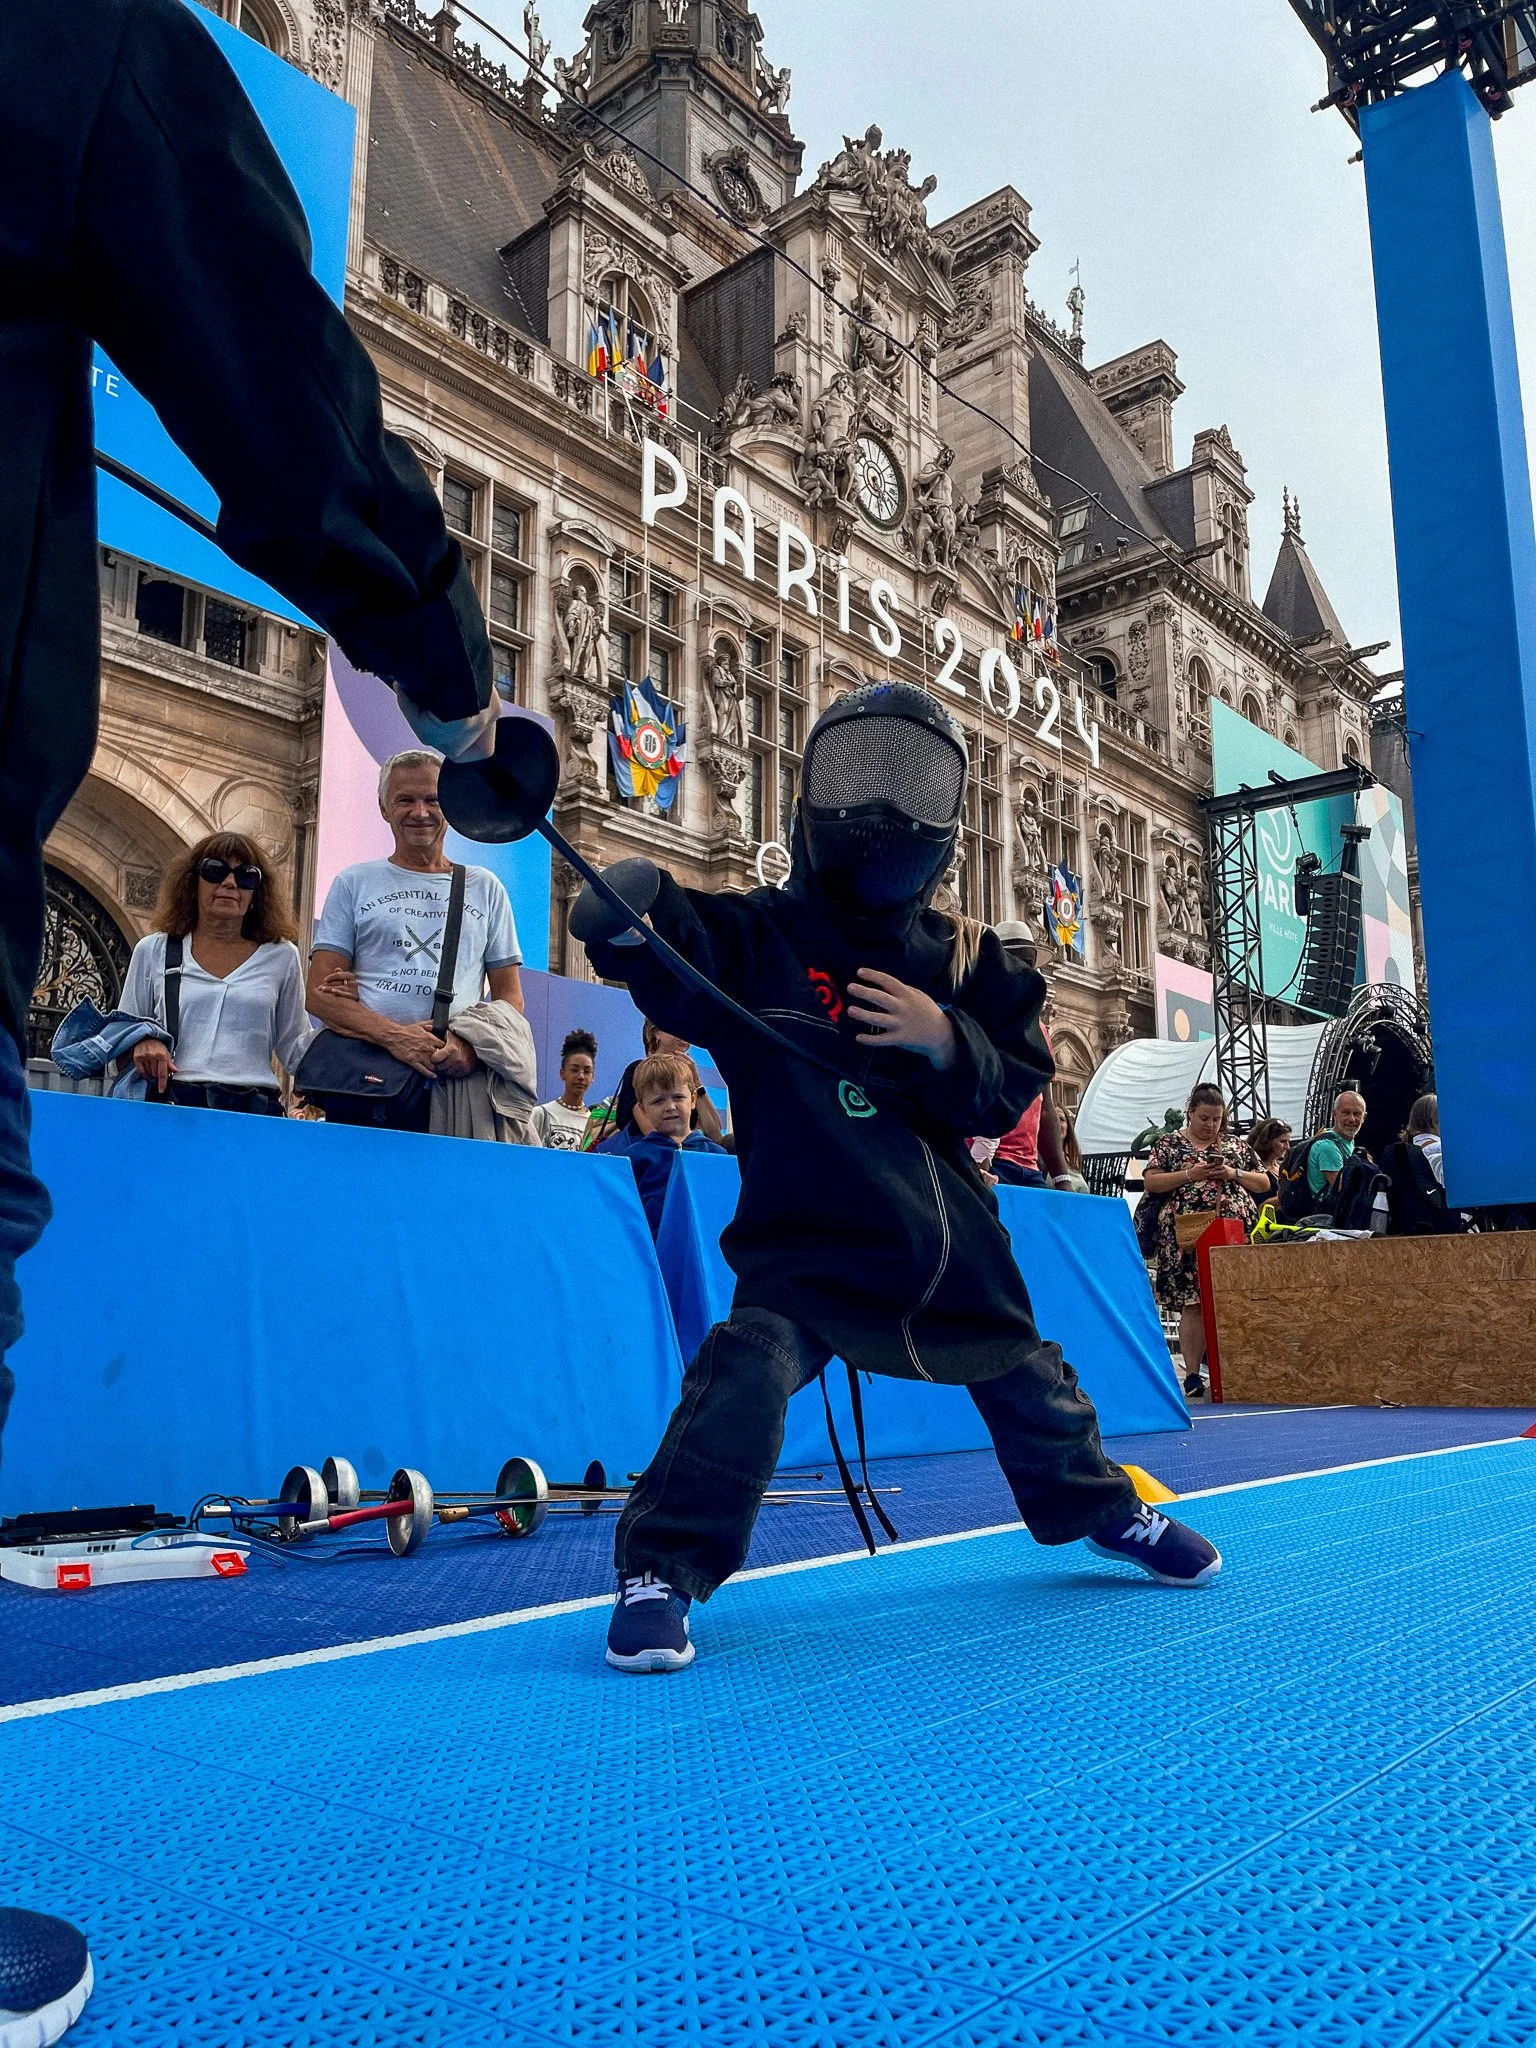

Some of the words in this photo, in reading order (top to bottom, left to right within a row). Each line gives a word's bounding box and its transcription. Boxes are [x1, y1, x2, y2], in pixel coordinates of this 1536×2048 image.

[92, 366, 119, 398] TE
[933, 617, 1099, 768] 2024
[360, 902, 376, 914] AN
[378, 890, 441, 906] ESSENTIAL
[405, 908, 449, 919] CREATIVI
[391, 969, 398, 977] IS
[400, 968, 419, 976] NOT
[421, 969, 438, 979] BEIN
[375, 979, 411, 994] AFRAID
[416, 984, 432, 996] TO
